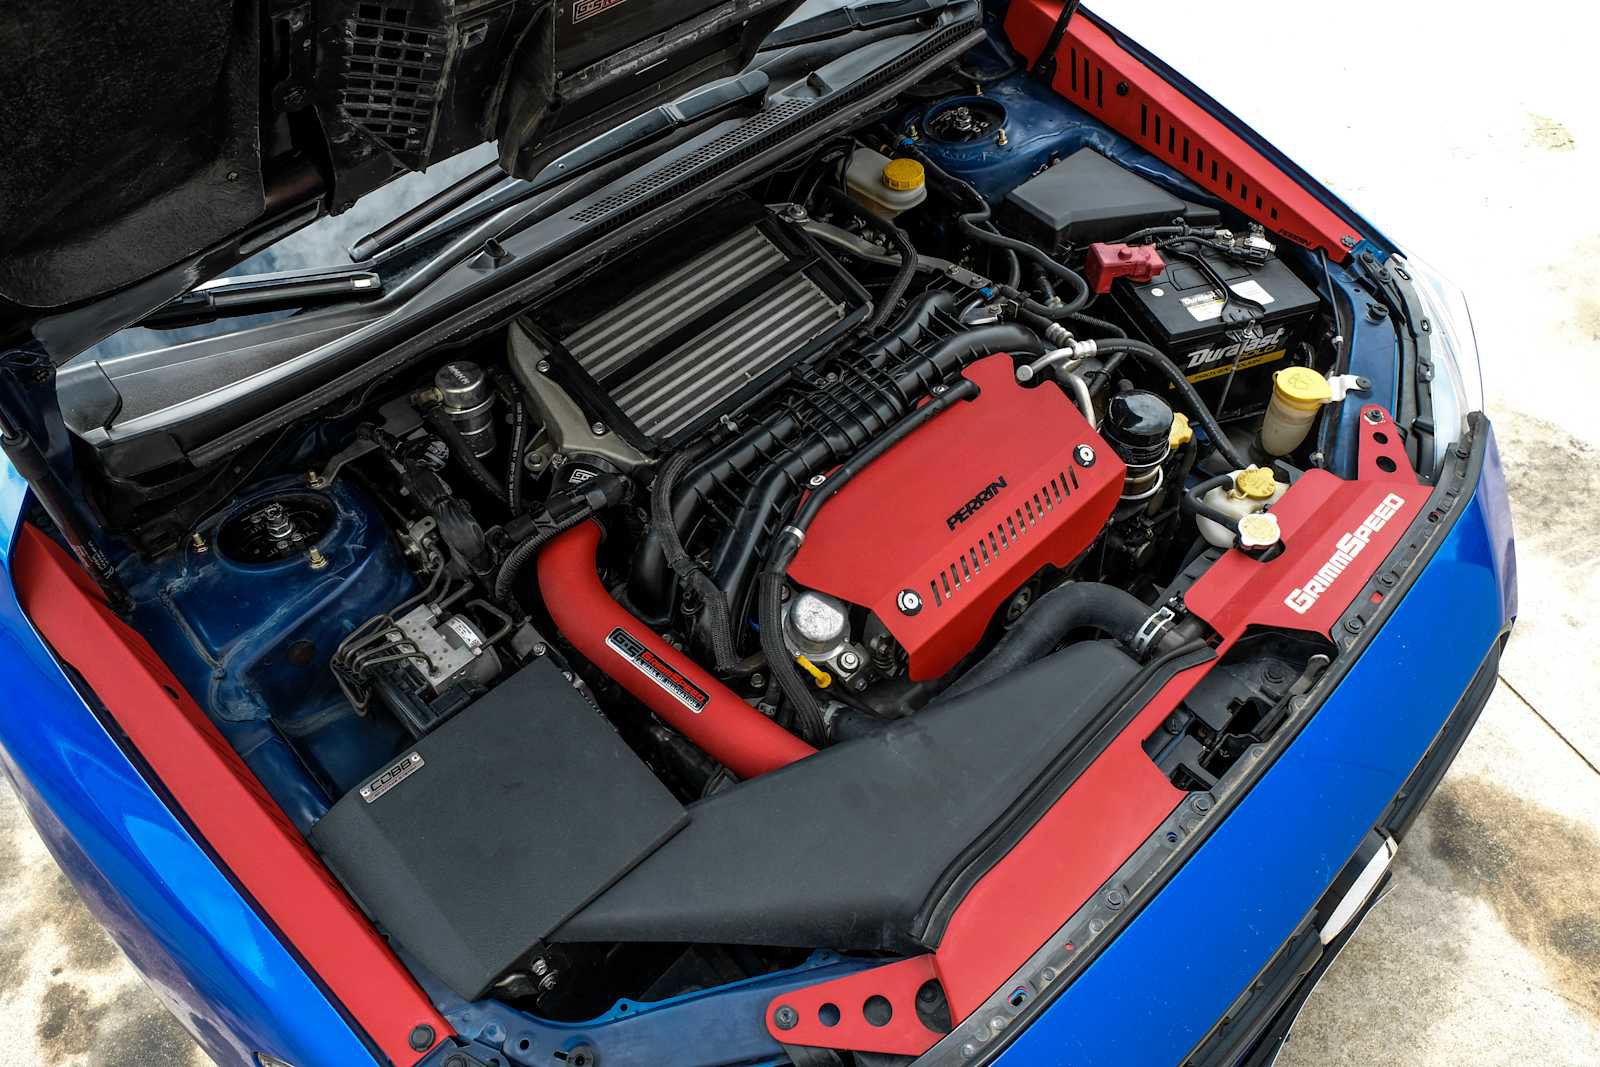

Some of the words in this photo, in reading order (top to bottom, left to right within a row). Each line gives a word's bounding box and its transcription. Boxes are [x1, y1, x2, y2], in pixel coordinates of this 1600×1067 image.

[1187, 327, 1286, 368] Duralast
[946, 475, 1007, 531] PERRIN
[370, 758, 412, 791] COBB
